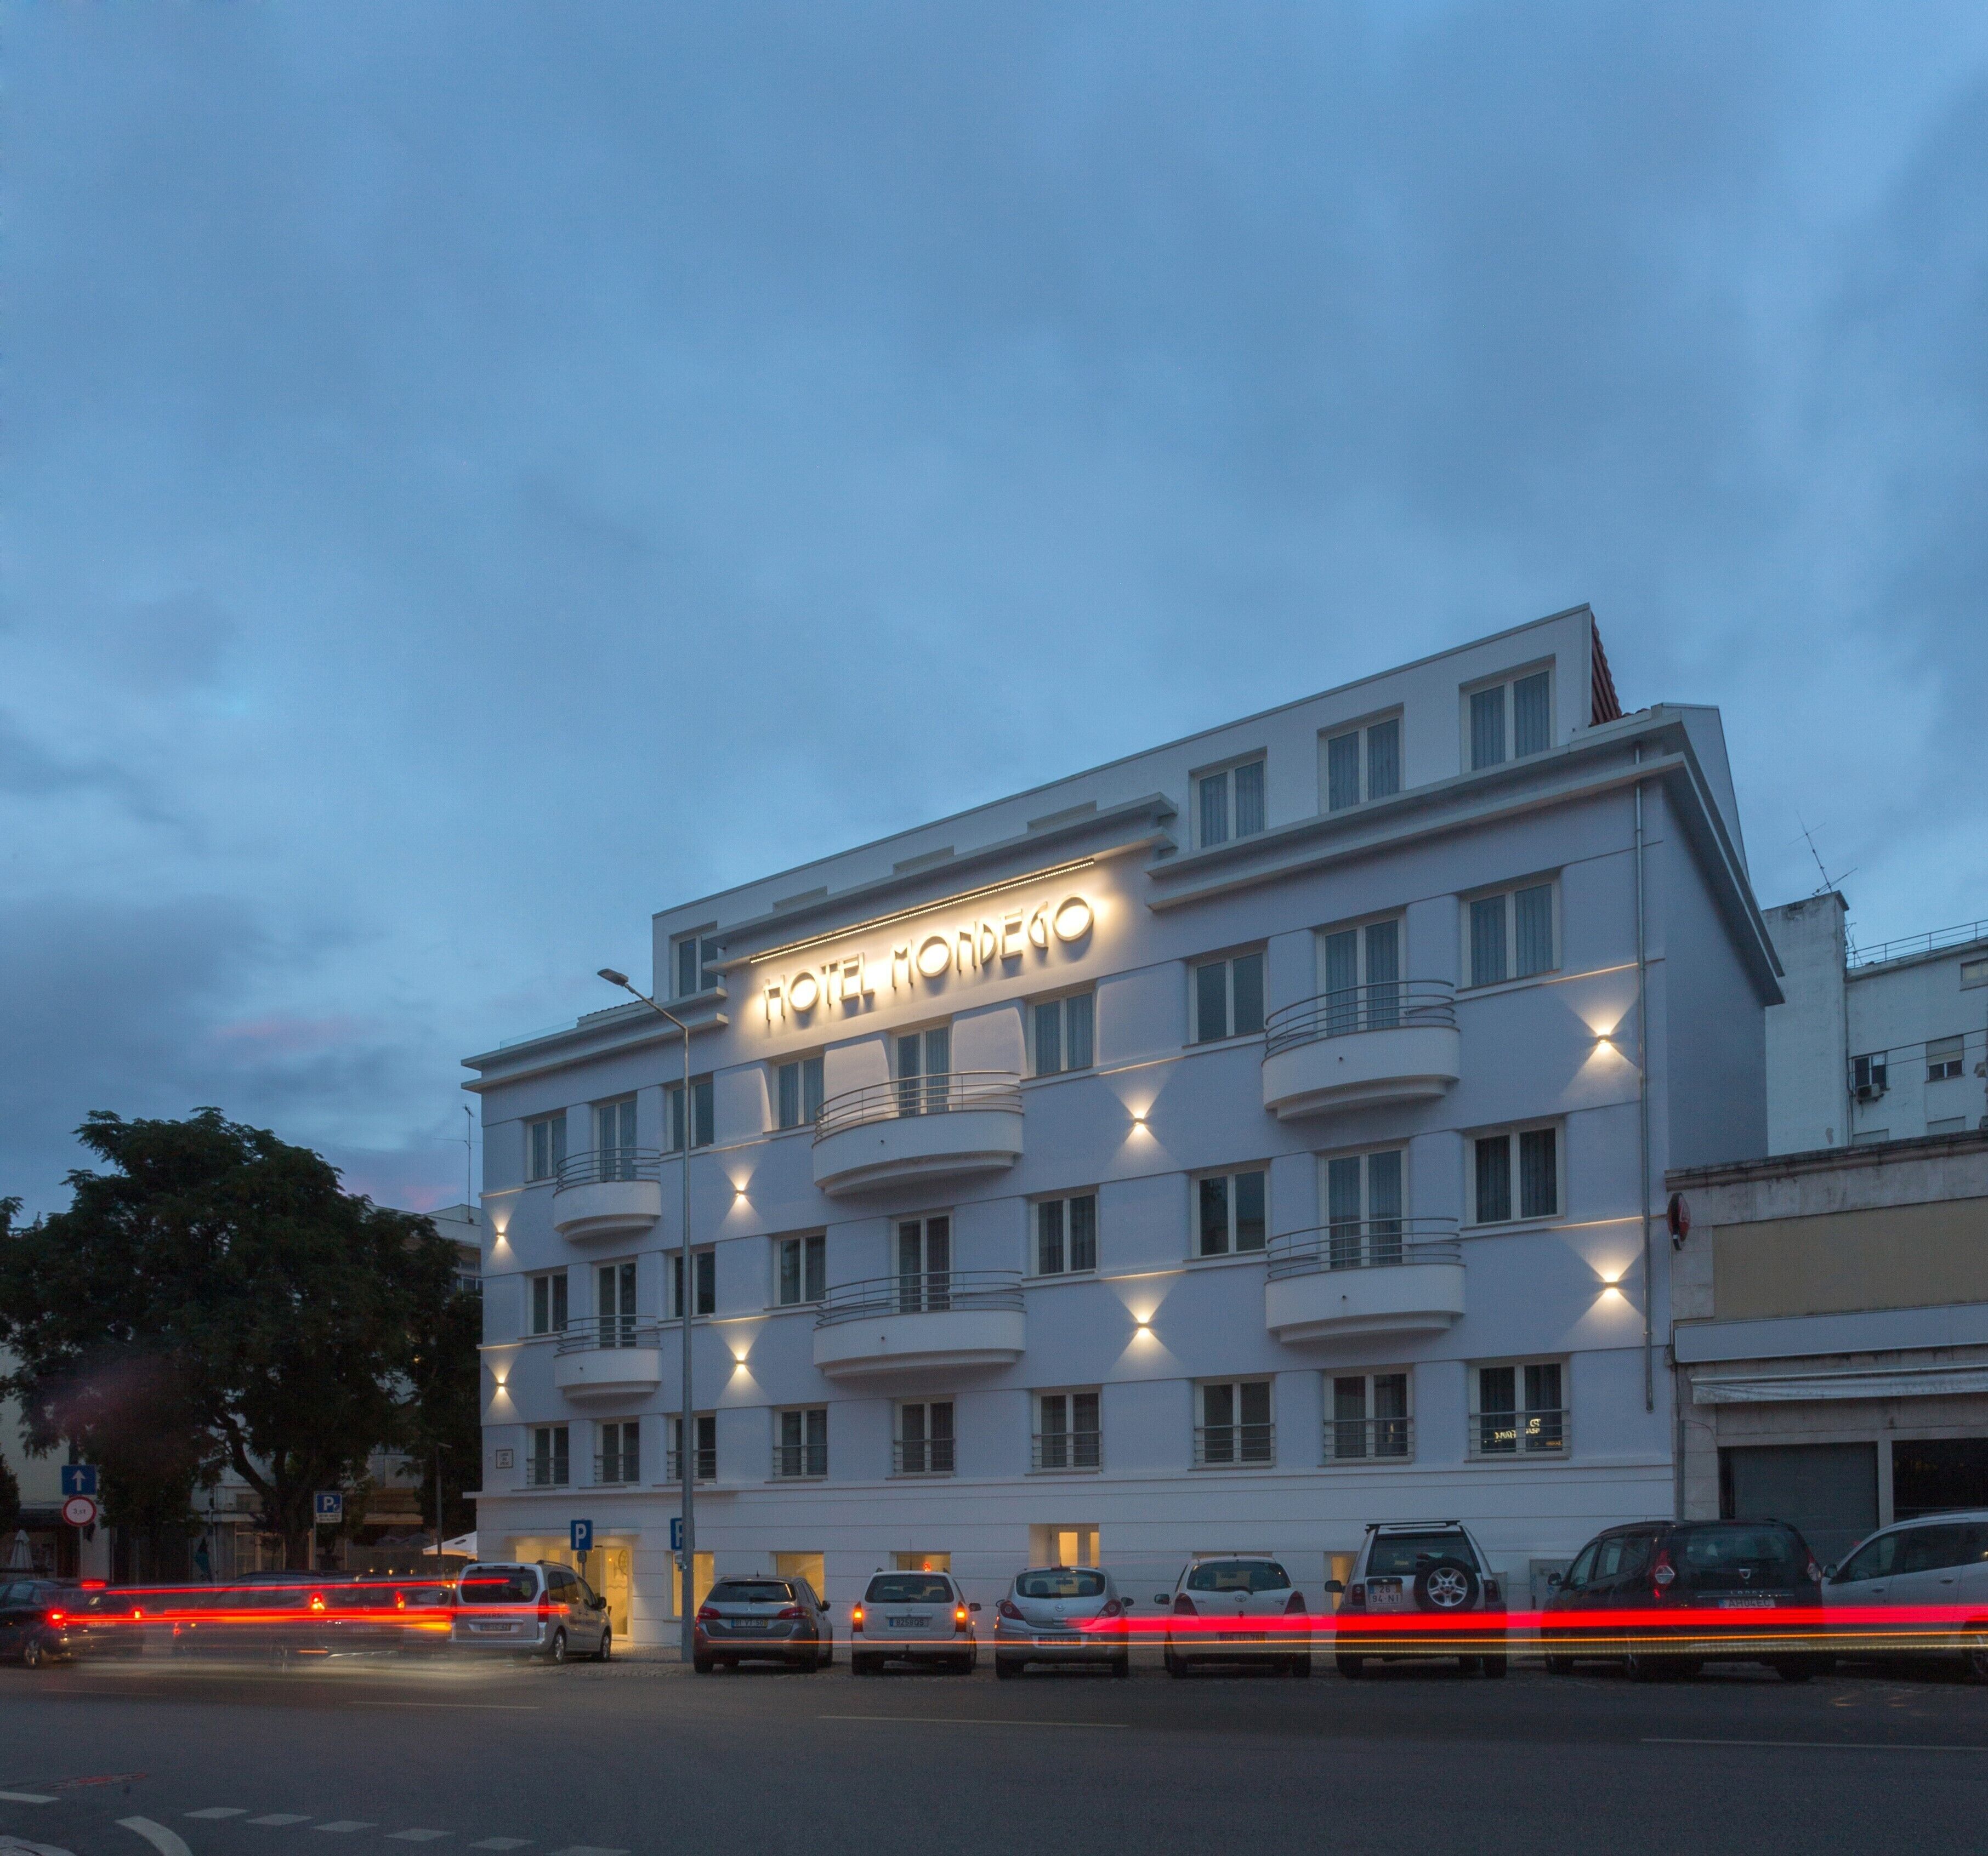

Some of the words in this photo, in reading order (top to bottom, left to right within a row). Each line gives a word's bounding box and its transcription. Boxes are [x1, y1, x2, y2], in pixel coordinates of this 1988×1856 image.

[763, 952, 874, 1021] HOTEL
[891, 892, 1094, 988] MONDEGO
[324, 1496, 334, 1511] P
[576, 1523, 587, 1548] P
[1379, 1585, 1391, 1593] 26
